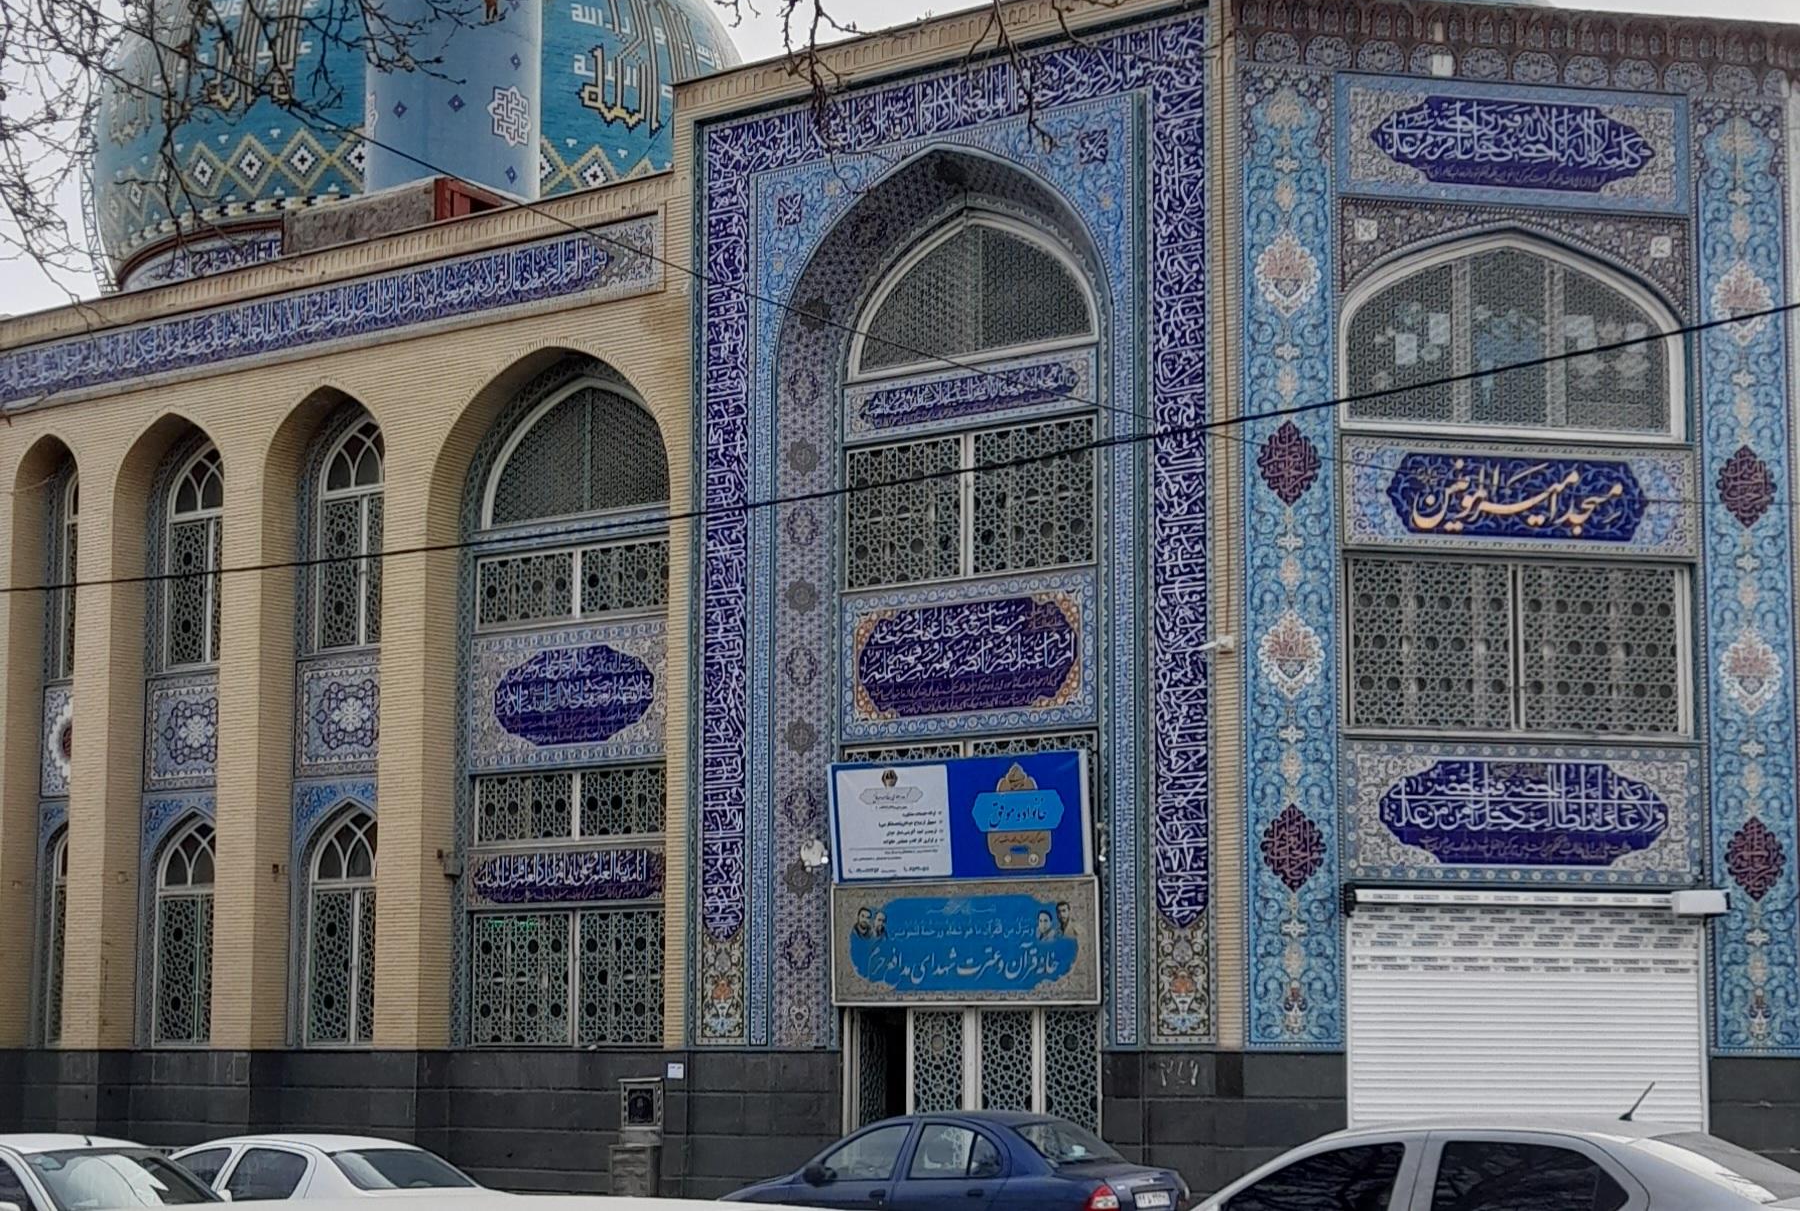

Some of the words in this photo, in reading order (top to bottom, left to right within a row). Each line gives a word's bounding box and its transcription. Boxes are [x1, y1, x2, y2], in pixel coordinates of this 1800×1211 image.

[956, 946, 1002, 982] عترت
[996, 958, 1005, 975] و
[1005, 942, 1038, 983] قرآن
